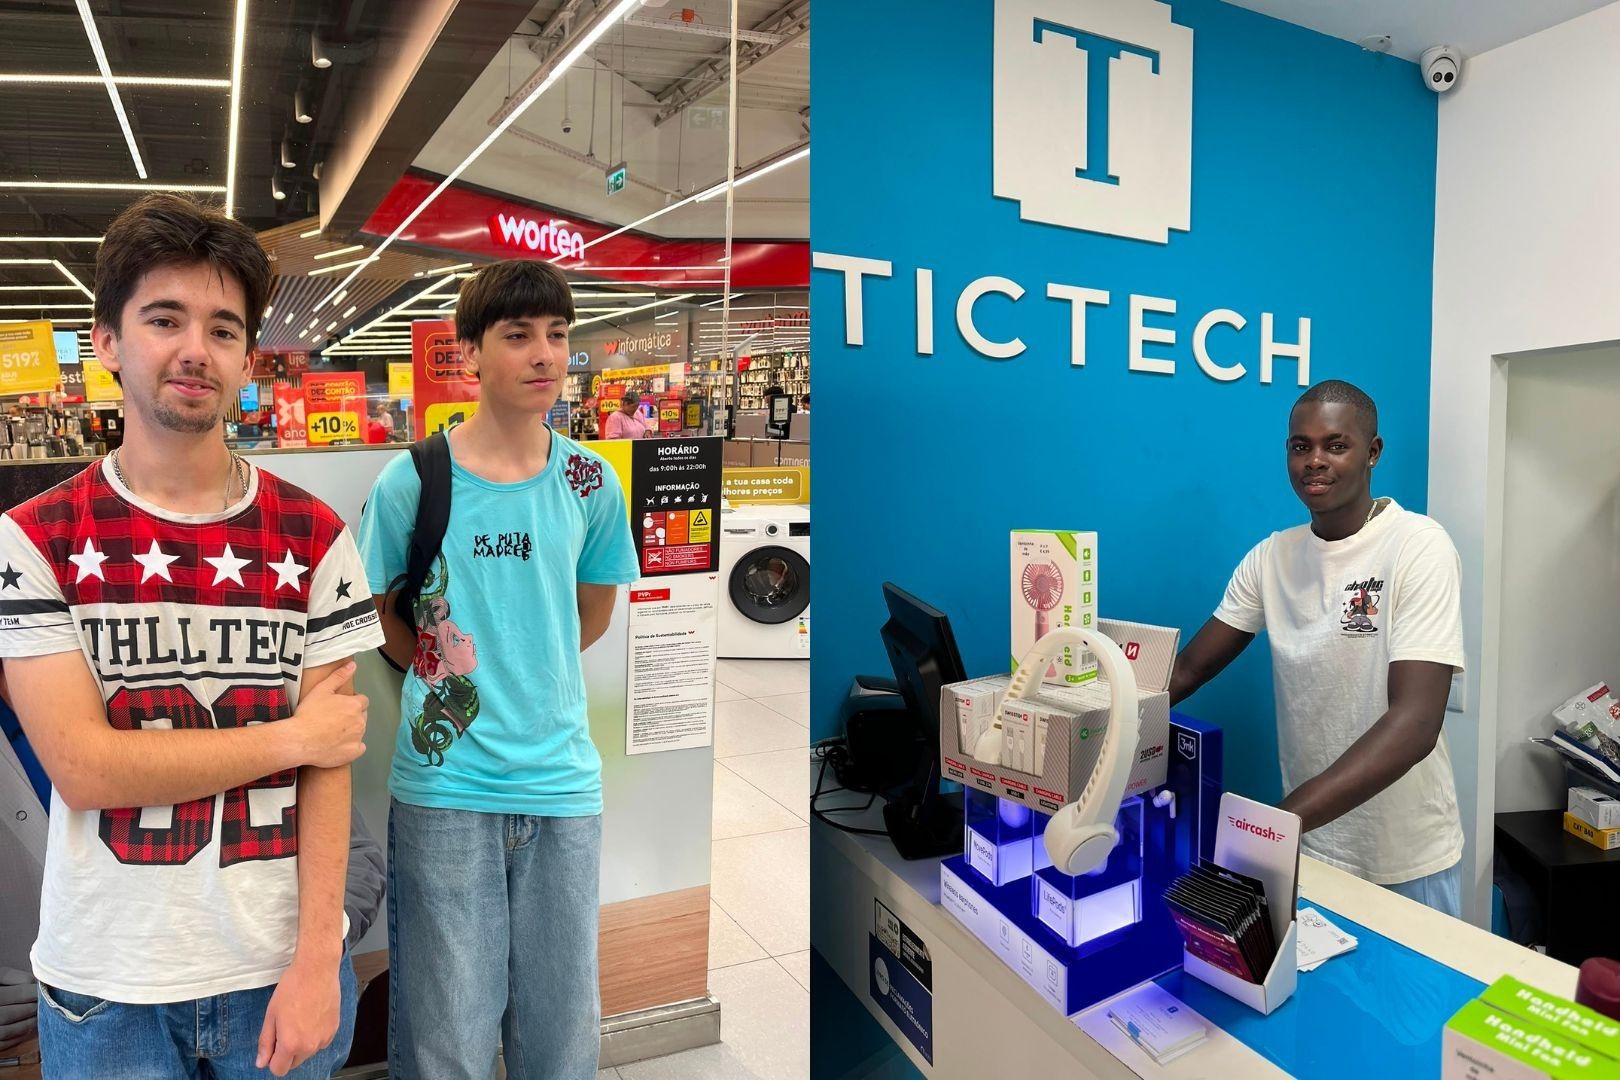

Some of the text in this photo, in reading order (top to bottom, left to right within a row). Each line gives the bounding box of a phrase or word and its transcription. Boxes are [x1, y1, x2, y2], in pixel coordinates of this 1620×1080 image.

[1033, 16, 1160, 186] T
[498, 213, 585, 259] worten
[812, 251, 1312, 387] TICTECH
[618, 331, 672, 353] informática
[311, 416, 356, 434] +10%
[657, 444, 700, 456] HORÁRIO
[655, 481, 700, 492] INFORMAÇÃO
[753, 488, 783, 496] preços
[773, 476, 794, 485] toda
[1229, 815, 1266, 836] aircash
[1515, 988, 1619, 1037] Handheld
[1526, 1004, 1589, 1036] Mini Fan
[1484, 1014, 1592, 1067] Handheld
[1495, 1032, 1562, 1067] Mini Fan
